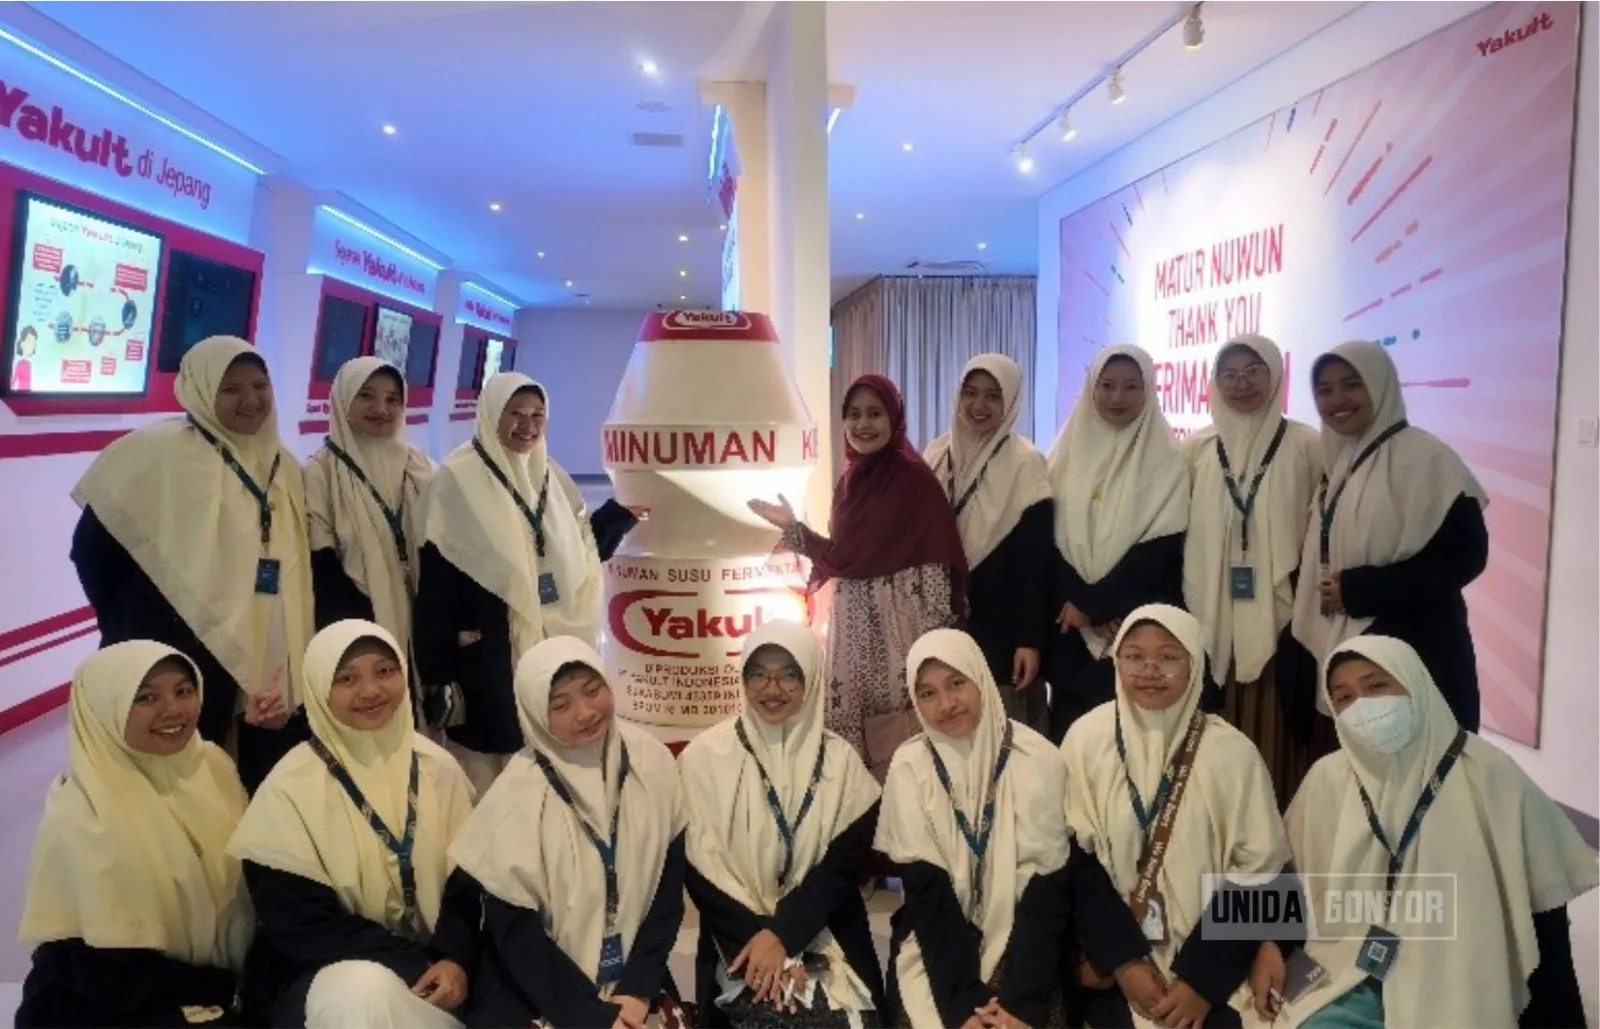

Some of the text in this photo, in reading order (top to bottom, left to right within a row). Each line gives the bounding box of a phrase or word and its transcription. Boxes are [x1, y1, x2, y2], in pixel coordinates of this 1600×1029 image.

[1476, 12, 1555, 57] Yakult
[0, 79, 211, 209] Yakult di Jepang
[1154, 223, 1285, 300] MATUR NUWUN
[683, 311, 734, 324] Yakult
[1168, 292, 1262, 348] THANK YOU
[1152, 358, 1212, 414] ERIMA
[604, 429, 775, 465] MINUMAN
[668, 568, 711, 583] SUSU
[641, 606, 763, 640] Yakul
